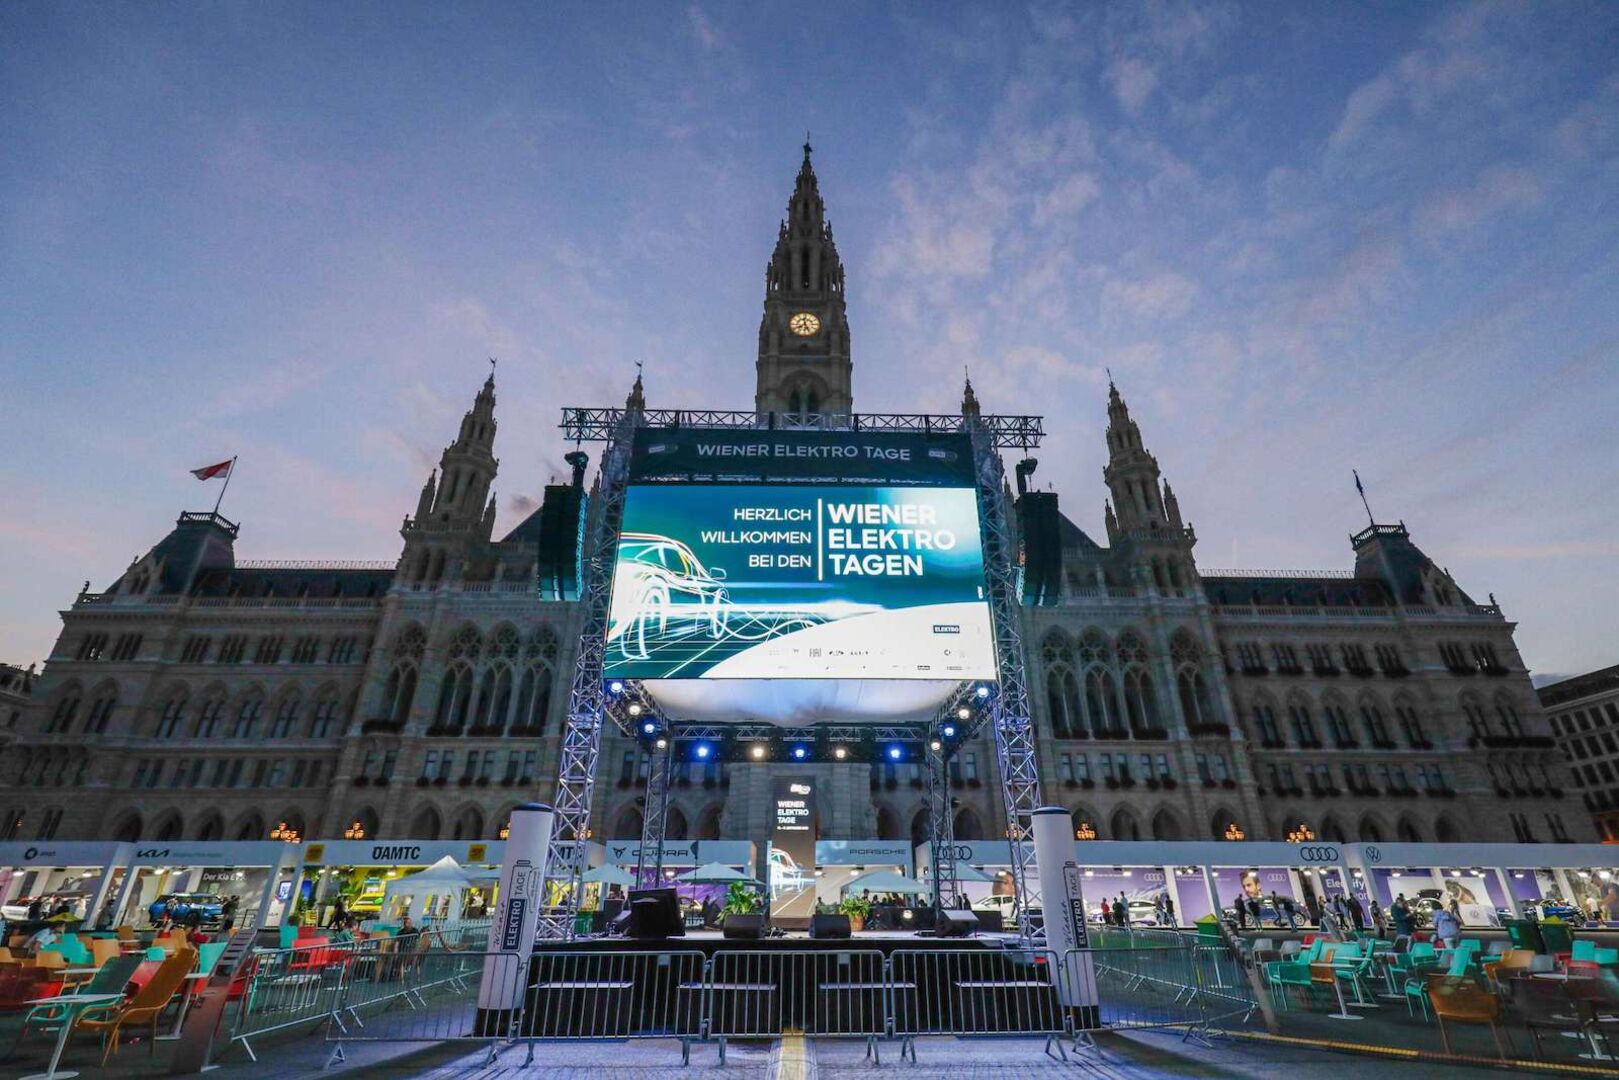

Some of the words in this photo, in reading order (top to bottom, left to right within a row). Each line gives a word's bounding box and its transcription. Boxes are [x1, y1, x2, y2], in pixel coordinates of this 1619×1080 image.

[697, 443, 769, 457] WIENER
[774, 444, 858, 458] ELEKTRO
[863, 446, 911, 460] TAGE
[734, 508, 812, 521] HERZLICH
[827, 503, 937, 525] WIENER
[701, 531, 812, 544] WILLKOMMEN
[828, 528, 956, 550] ELEKTRO
[748, 554, 774, 568] BEI
[777, 554, 812, 568] DEN
[828, 554, 924, 576] TAGEN
[777, 800, 805, 808] WIENER
[777, 808, 809, 816] ELEKTRO
[777, 816, 796, 824] TAGE
[507, 900, 522, 947] ELEKTRO
[515, 871, 526, 895] TAGE
[1073, 900, 1086, 946] ELEKTRO
